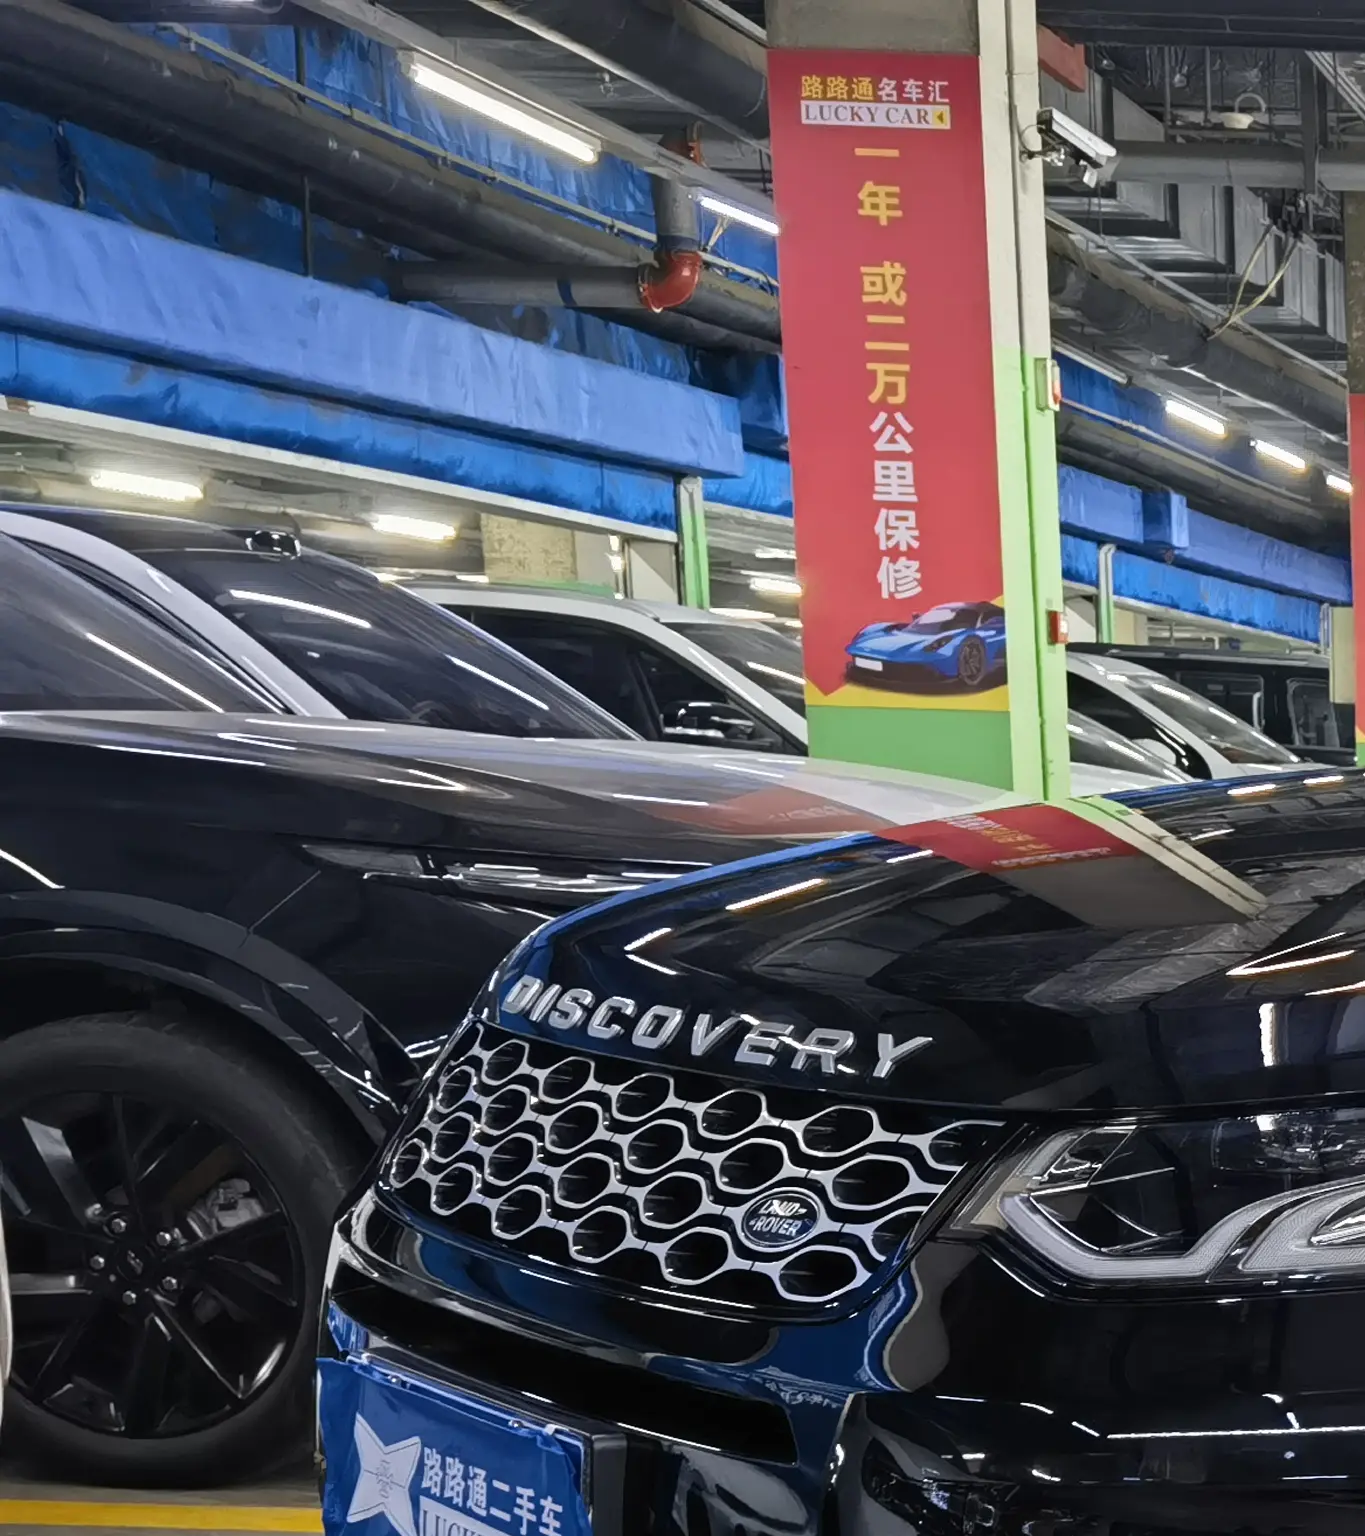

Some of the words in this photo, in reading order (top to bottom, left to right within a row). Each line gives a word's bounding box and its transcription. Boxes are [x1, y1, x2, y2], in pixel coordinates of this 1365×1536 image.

[801, 75, 949, 102] 路路通名车汇
[804, 103, 879, 123] LUCKY
[885, 107, 931, 125] CAR
[501, 974, 934, 1079] DISCOVERY
[752, 1216, 802, 1236] ROVER
